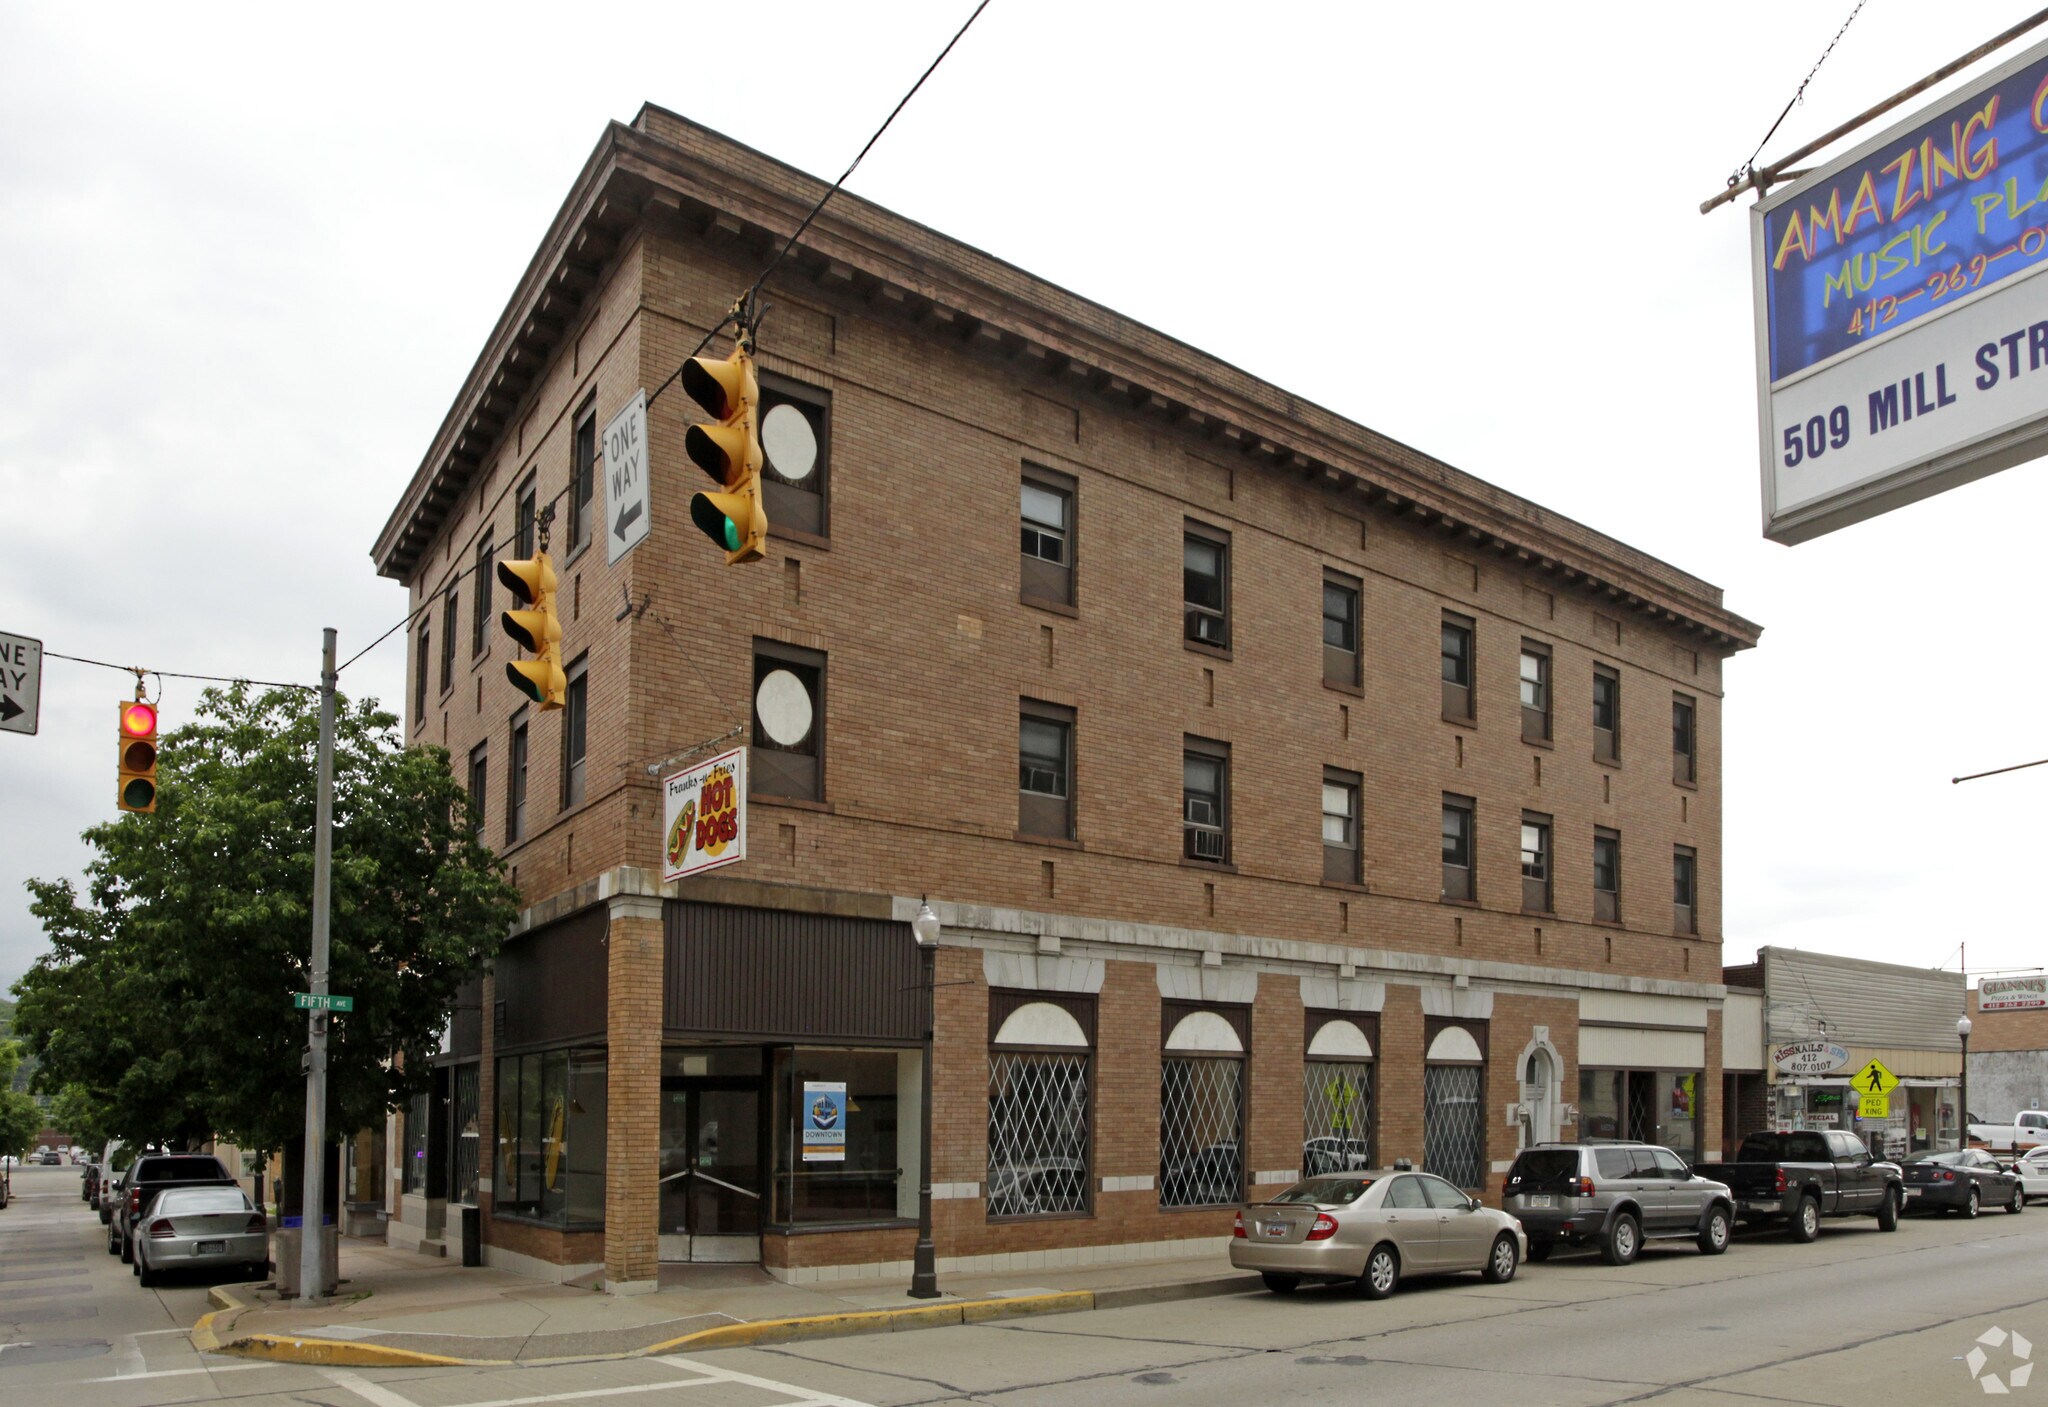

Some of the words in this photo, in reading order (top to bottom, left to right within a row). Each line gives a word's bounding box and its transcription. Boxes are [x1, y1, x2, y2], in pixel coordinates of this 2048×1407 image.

[1772, 94, 2000, 271] AMAZING
[1823, 210, 1947, 308] MUSIC
[1847, 224, 2048, 335] 412-269-0
[1784, 405, 1850, 468] 509
[1868, 362, 1957, 436] MILL
[1975, 320, 2048, 391] STR
[611, 413, 638, 463] ONE
[612, 448, 640, 501] WAY
[700, 775, 734, 817] HOT
[695, 807, 738, 851] DOGS
[301, 995, 331, 1008] FIFTH
[1801, 1053, 1817, 1062] 412
[1807, 1113, 1835, 1121] PECIAL
[1865, 1098, 1882, 1107] PED
[1865, 1107, 1882, 1115] XING
